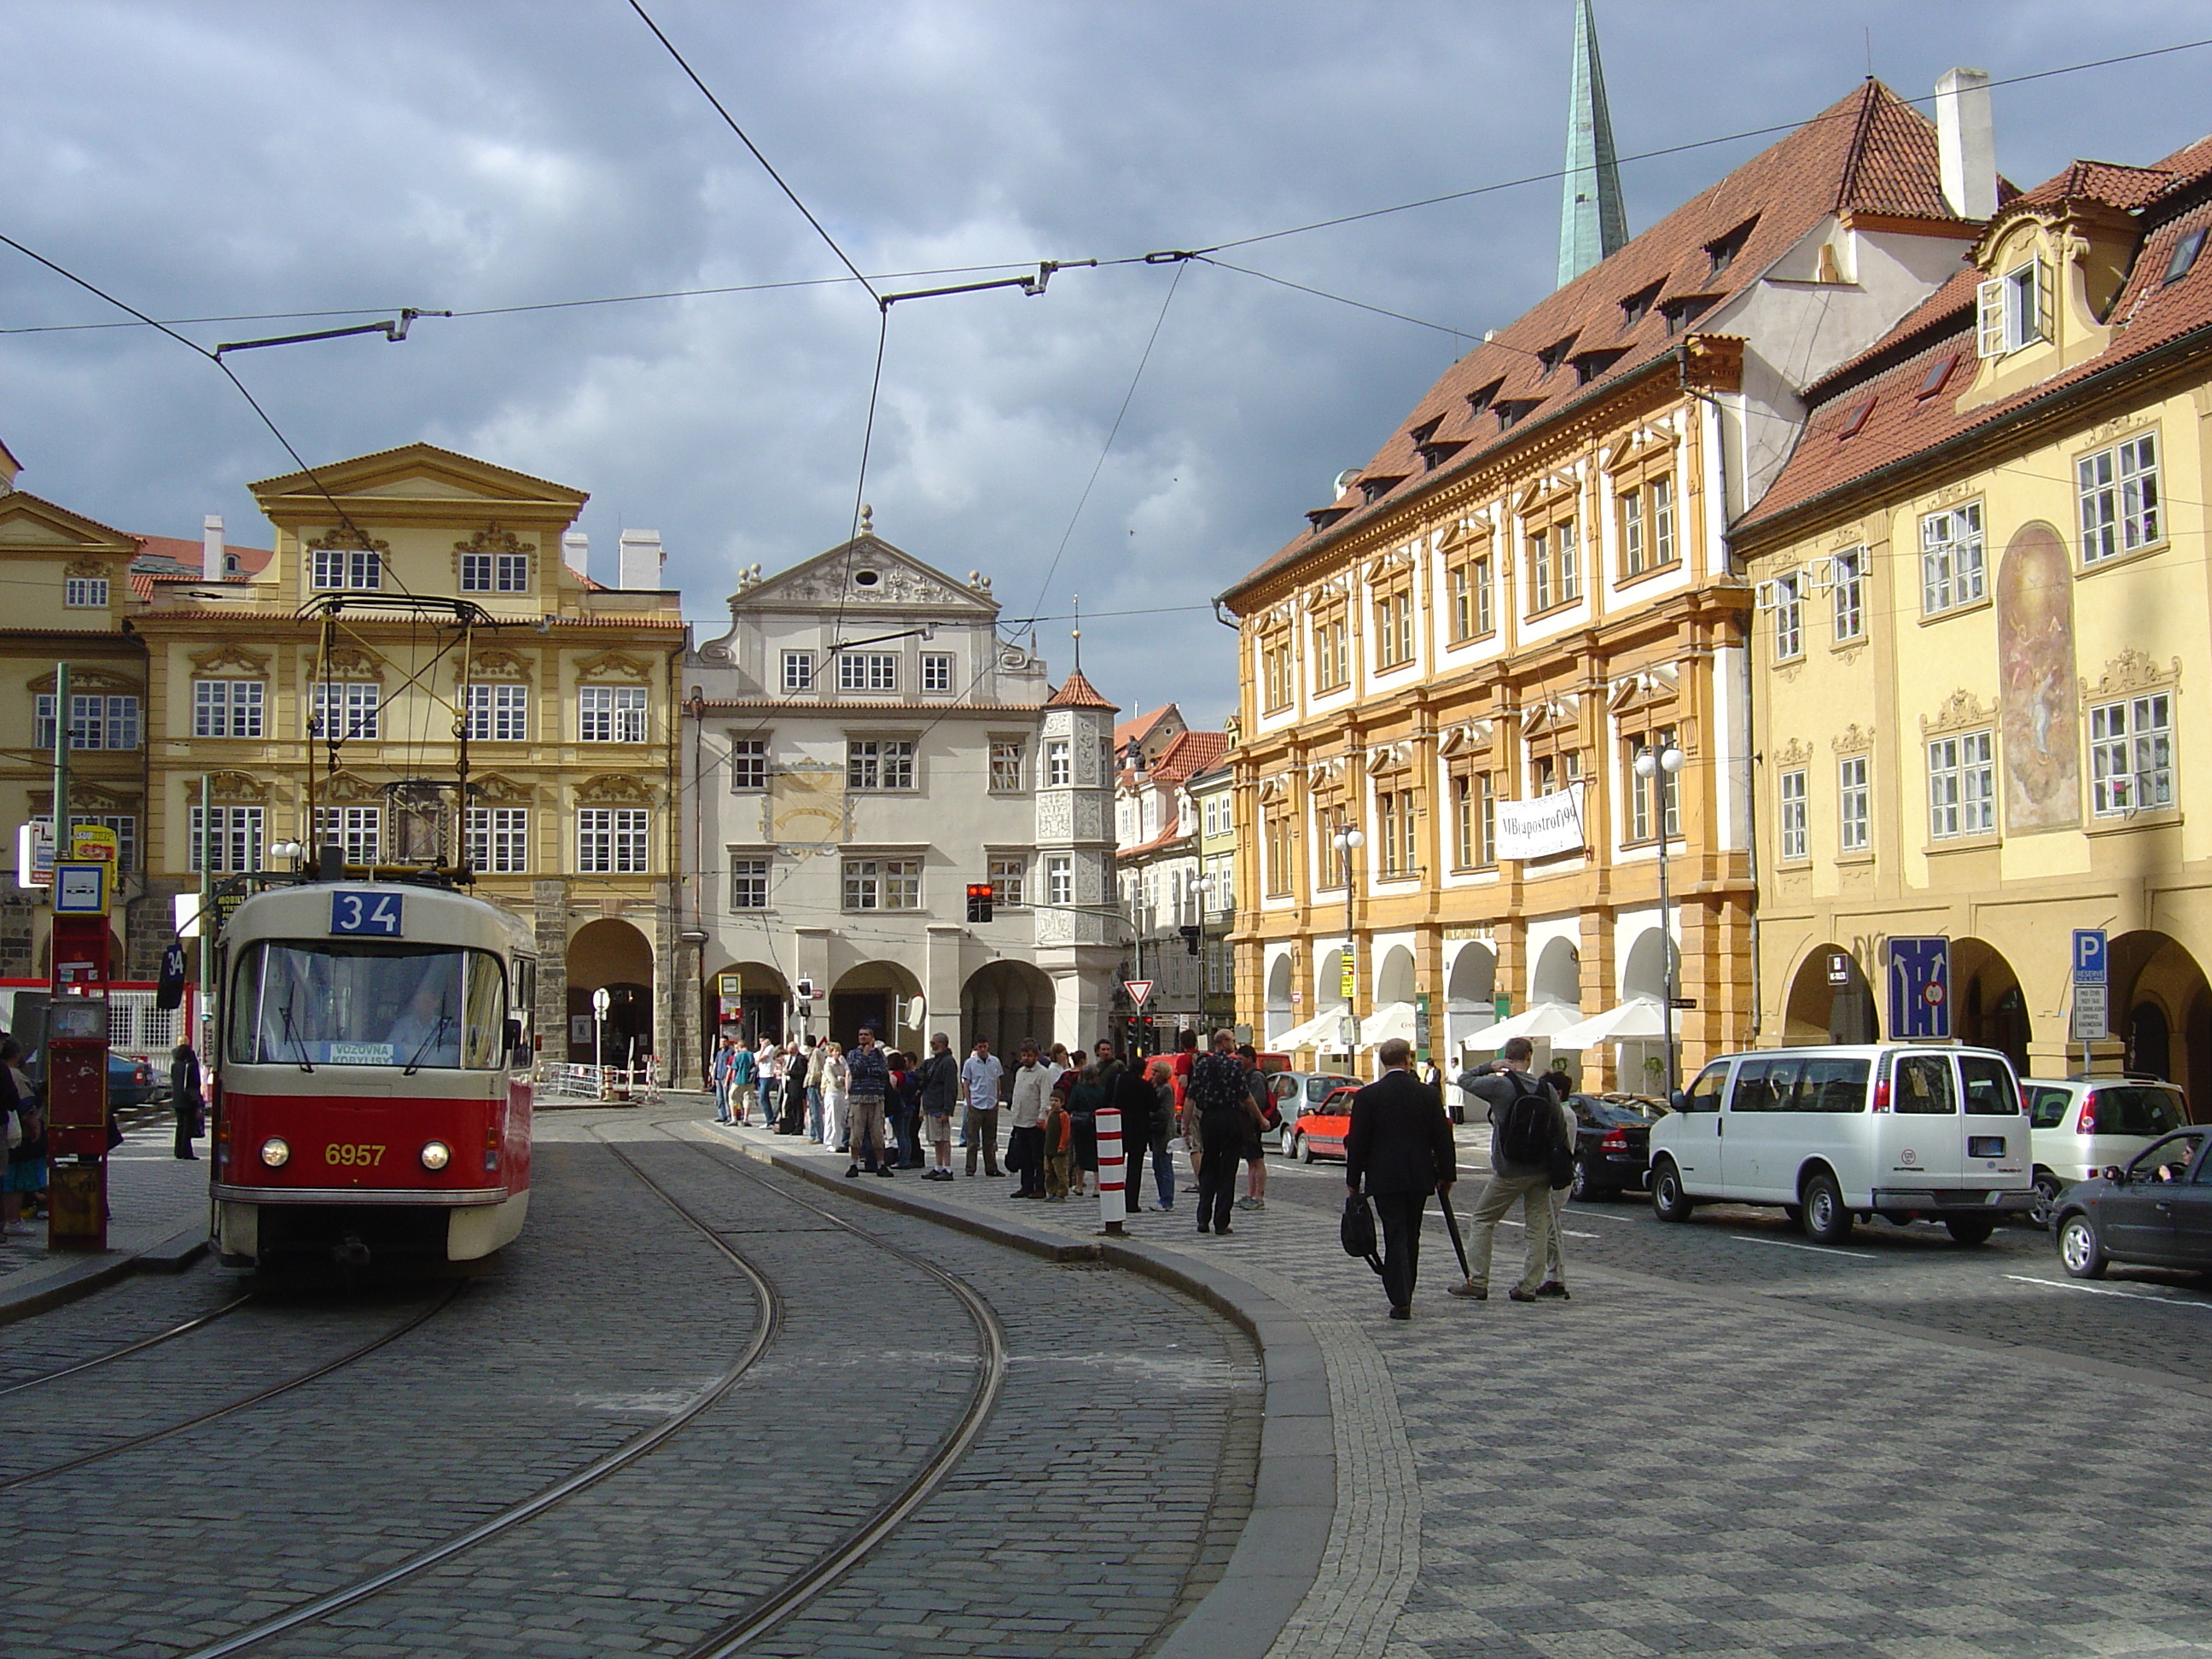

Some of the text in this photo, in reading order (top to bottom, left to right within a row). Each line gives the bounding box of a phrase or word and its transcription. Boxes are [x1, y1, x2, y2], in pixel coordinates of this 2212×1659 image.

[75, 831, 114, 841] SUBWAY
[341, 895, 396, 932] 34
[168, 950, 183, 976] 34
[2081, 936, 2099, 967] P
[336, 1045, 388, 1055] VOZOVNA
[325, 1144, 386, 1166] 6957
